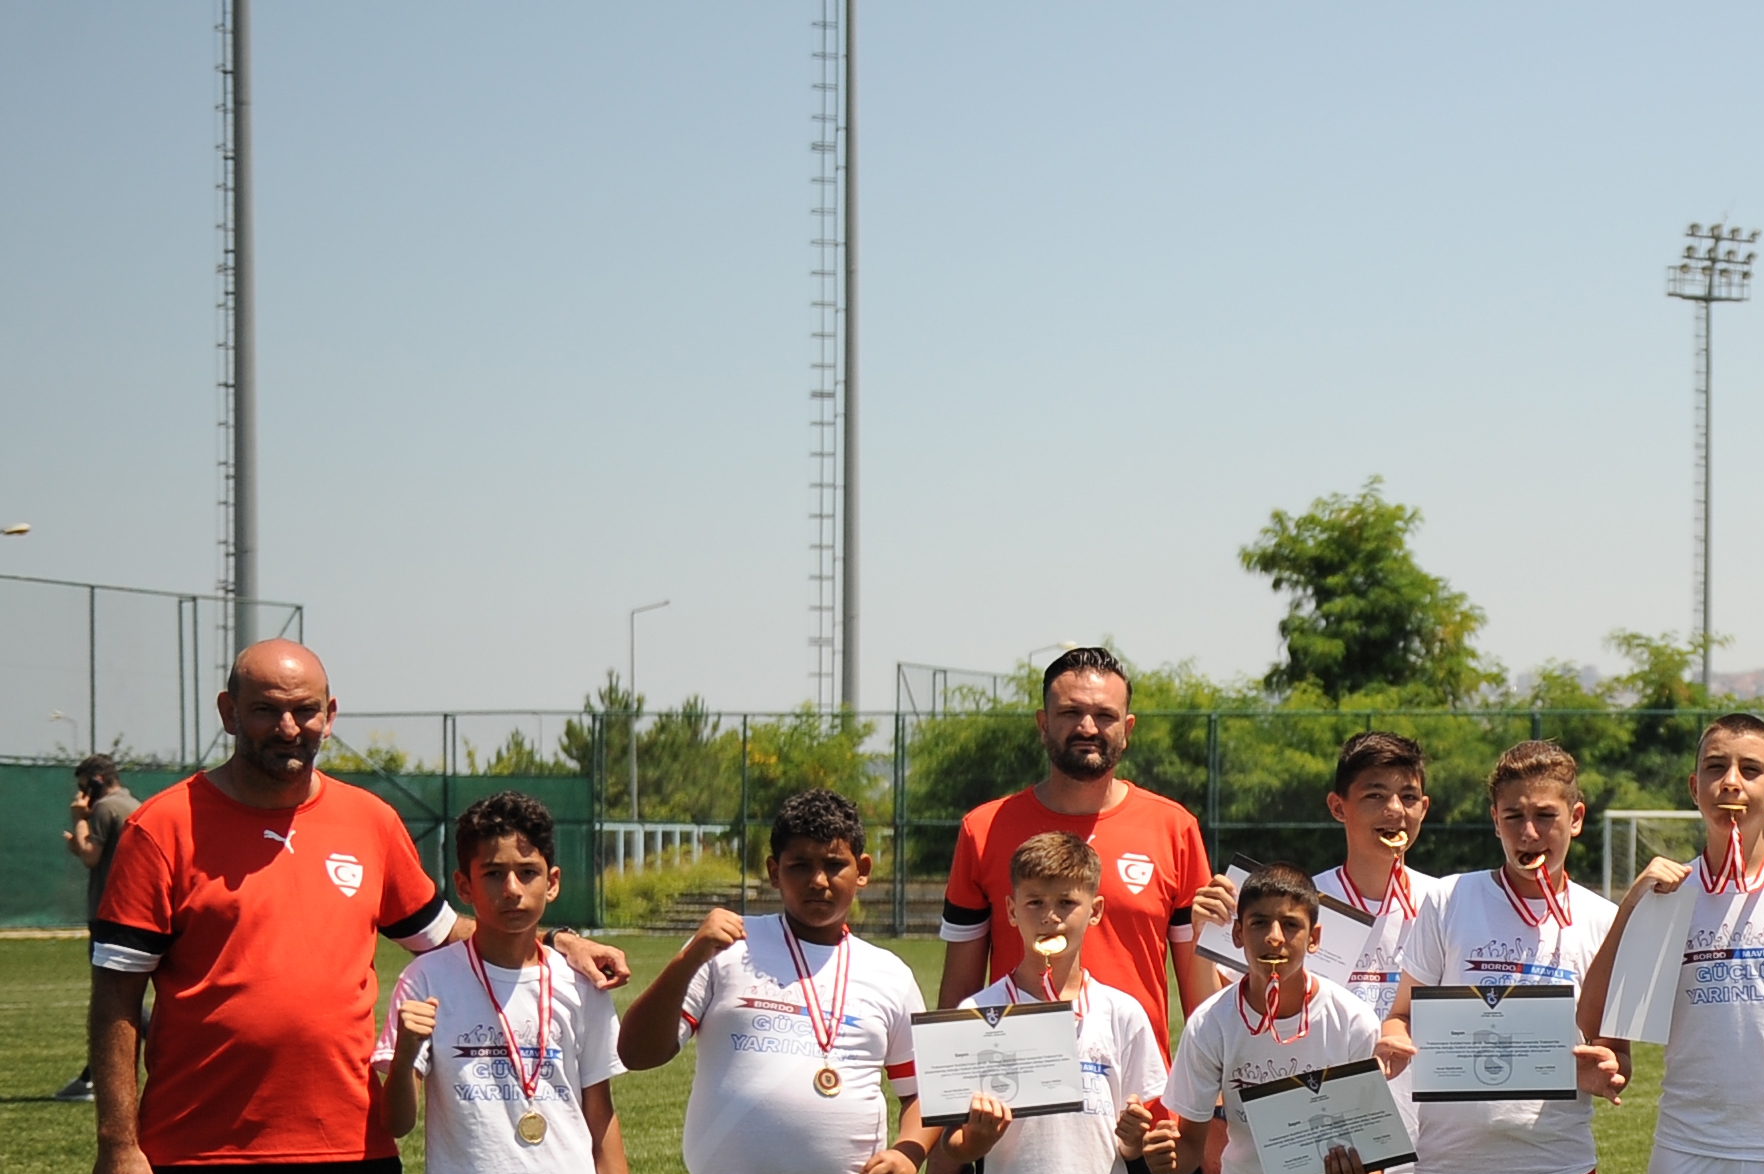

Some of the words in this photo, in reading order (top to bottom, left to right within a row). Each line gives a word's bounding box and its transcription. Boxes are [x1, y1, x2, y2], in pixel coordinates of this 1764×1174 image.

[1693, 951, 1727, 960] BORDO
[1481, 963, 1516, 971] BORDO
[1352, 985, 1396, 1006] GÜÇ
[754, 1000, 794, 1013] BORDO
[470, 1048, 507, 1056] BORDO
